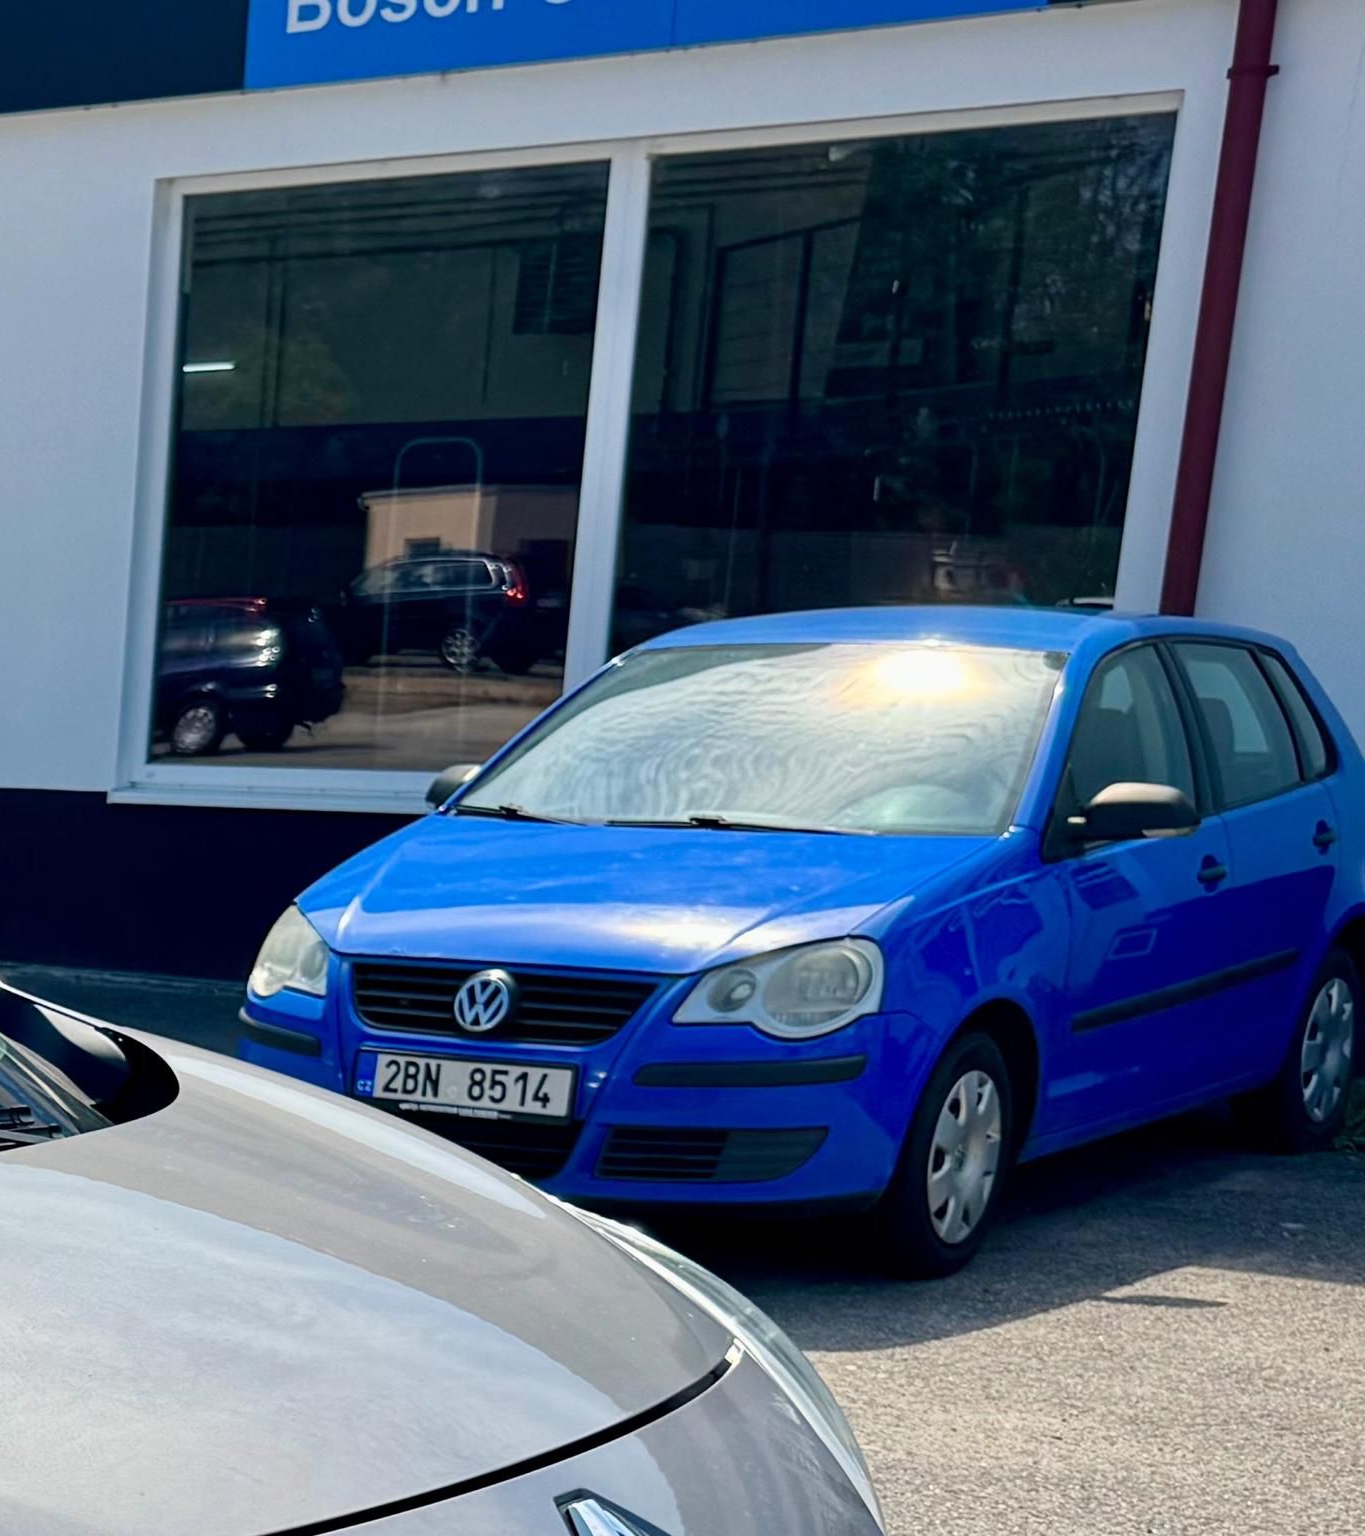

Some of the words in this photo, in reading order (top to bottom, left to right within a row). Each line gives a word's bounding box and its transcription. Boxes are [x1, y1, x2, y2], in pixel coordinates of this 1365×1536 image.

[286, 0, 506, 33] Bos
[357, 1079, 372, 1092] CZ
[382, 1059, 442, 1098] 2BN
[467, 1067, 551, 1110] 8514
